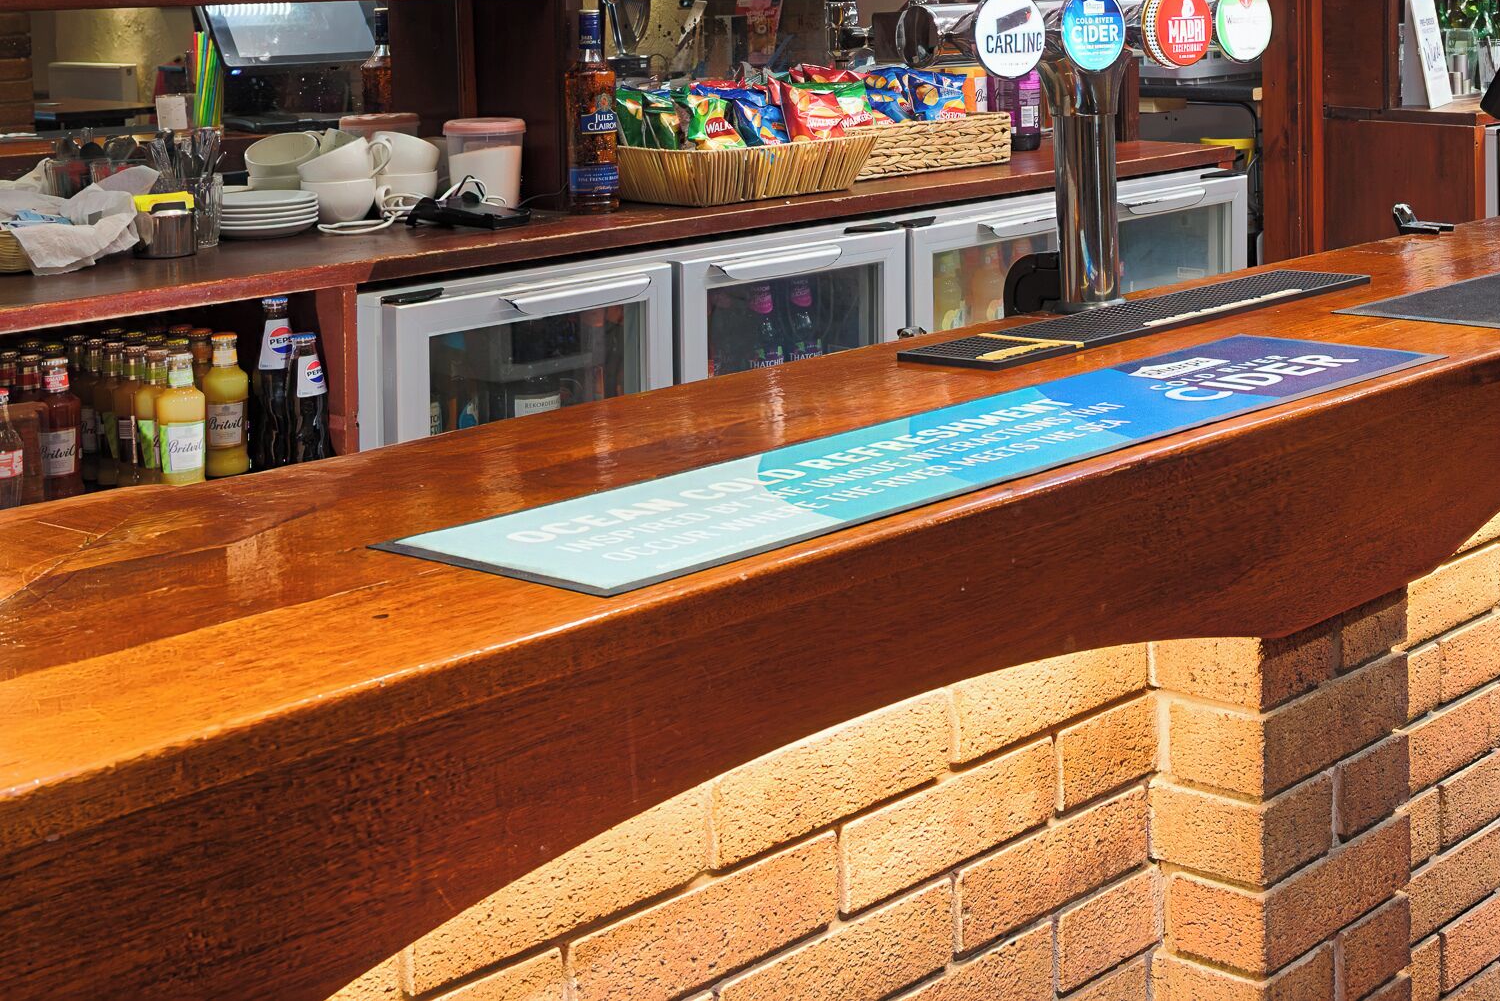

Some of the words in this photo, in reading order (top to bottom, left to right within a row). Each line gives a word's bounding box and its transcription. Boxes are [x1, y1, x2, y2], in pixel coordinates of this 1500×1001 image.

[1075, 17, 1094, 25] COLD
[1095, 17, 1114, 25] RIVER
[986, 31, 1043, 55] CARLING
[1071, 24, 1119, 43] CIDER
[587, 121, 617, 131] CLAIRON
[595, 113, 614, 123] JULES
[841, 111, 874, 128] WALKERS
[1150, 372, 1216, 392] COLD
[1215, 354, 1289, 374] RIVER
[1164, 354, 1361, 401] CIDER
[506, 497, 678, 545] OCEAN
[678, 467, 807, 504] COLD
[806, 398, 1075, 471] REFRESHMENT
[555, 510, 712, 555] INSPIRED
[708, 499, 753, 518] BY
[757, 482, 816, 505] THE
[809, 460, 910, 489] UNIQUE
[906, 414, 1074, 465] INTERACTIONS
[1060, 401, 1126, 421] THAT
[600, 529, 712, 563] OCCUR
[708, 500, 830, 543] WHERE
[826, 486, 884, 503] THE
[880, 459, 963, 489] RIVER
[953, 442, 1036, 467] MEETS
[1030, 429, 1088, 448] THE
[1074, 416, 1132, 435] SEA
